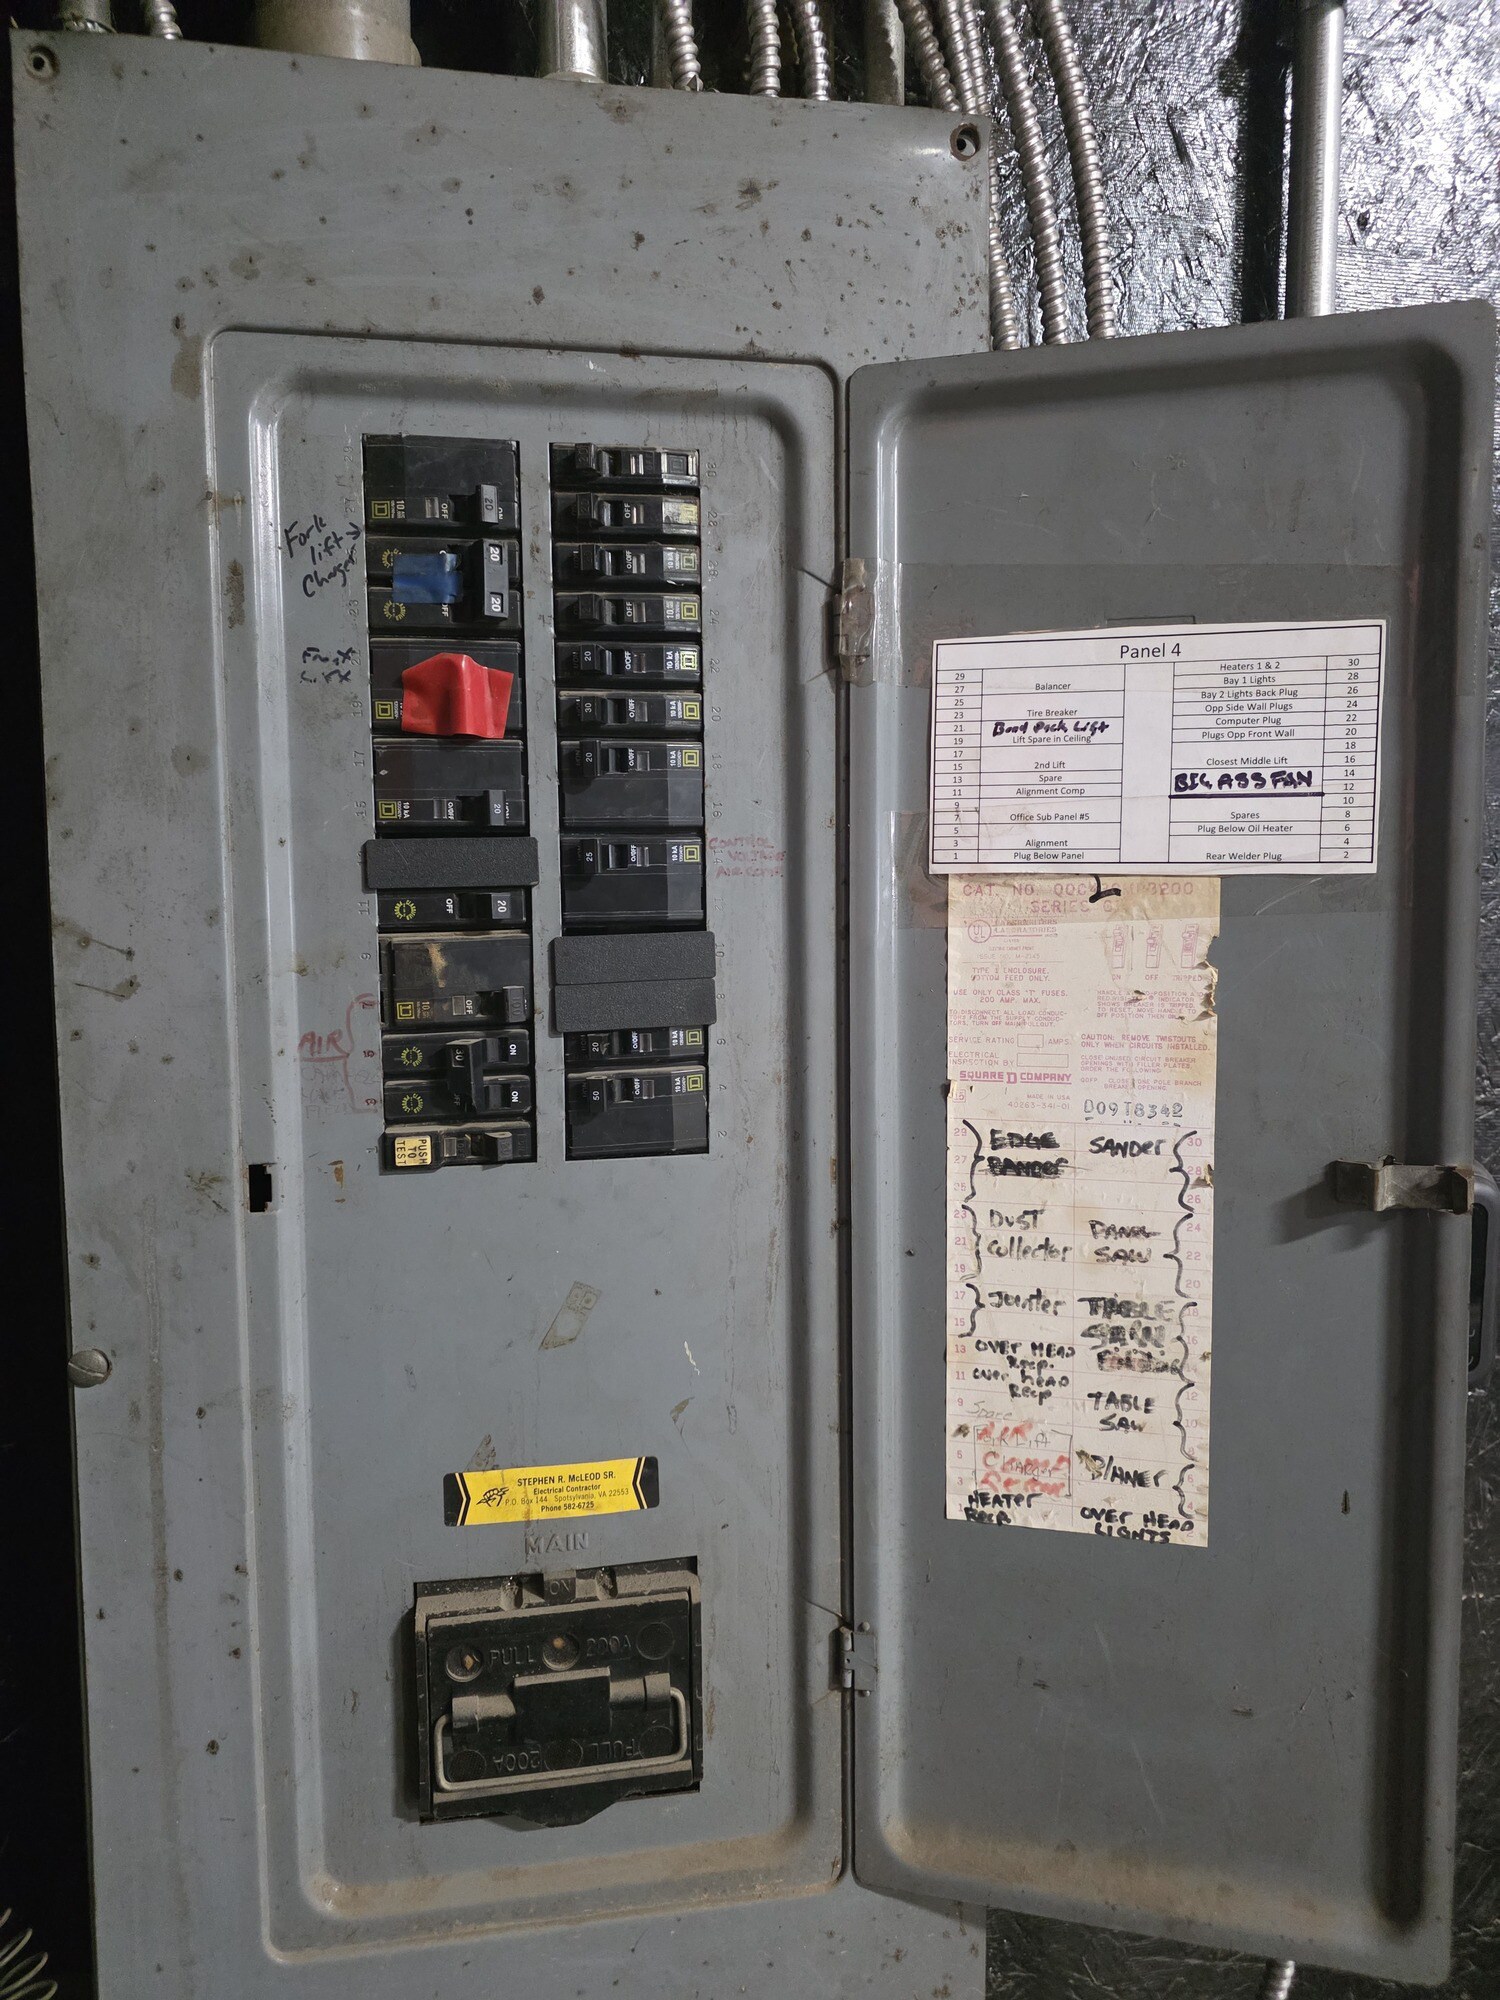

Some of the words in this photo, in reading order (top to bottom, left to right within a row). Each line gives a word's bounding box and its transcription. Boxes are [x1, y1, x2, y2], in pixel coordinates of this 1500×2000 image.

[490, 547, 500, 561] 20
[492, 598, 500, 611] 20
[585, 651, 591, 661] 20
[1120, 644, 1165, 659] Panel
[1170, 643, 1181, 657] 4
[1220, 662, 1254, 670] Heaters
[1348, 658, 1359, 666] 30
[1224, 676, 1239, 685] Bay
[1250, 675, 1276, 684] Lights
[1348, 672, 1359, 680] 28
[1201, 691, 1217, 699] Bay
[1228, 690, 1253, 699] Lights
[1256, 689, 1276, 697] Back
[1280, 688, 1298, 697] Plug
[1347, 686, 1358, 694] 26
[585, 703, 591, 712] 30
[1205, 703, 1223, 713] Opp
[1227, 703, 1245, 711] Side
[1248, 702, 1267, 710] Wall
[1270, 702, 1293, 711] Plugs
[1347, 700, 1358, 708] 24
[1216, 717, 1259, 726] Computer
[1263, 716, 1281, 725] Plug
[1346, 714, 1357, 722] 22
[1202, 730, 1224, 740] Plugs
[1227, 730, 1245, 739] Opp
[1249, 730, 1272, 738] Front
[1275, 729, 1294, 737] Wall
[1346, 728, 1356, 736] 20
[1013, 735, 1026, 743] Lift
[1028, 736, 1051, 744] Spare
[1064, 735, 1091, 743] Ceiling
[586, 752, 592, 762] 20
[1207, 757, 1238, 766] Closest
[1241, 757, 1271, 765] Middle
[1274, 756, 1288, 764] Lift
[1039, 774, 1062, 782] Spare
[1344, 769, 1355, 777] 14
[1174, 772, 1212, 792] BIG
[1217, 772, 1266, 789] ASS
[1270, 770, 1312, 788] FAN
[1016, 787, 1058, 796] Alignment
[1061, 787, 1085, 795] Comp
[1344, 783, 1354, 791] 12
[494, 804, 501, 814] 20
[1010, 813, 1034, 821] Office
[1231, 811, 1260, 820] Spares
[1198, 824, 1217, 834] Plug
[1219, 824, 1246, 832] Below
[1249, 824, 1260, 832] Oil
[1263, 824, 1293, 832] Heater
[1026, 839, 1068, 847] Alignment
[586, 852, 592, 861] 25
[1014, 852, 1031, 860] Plug
[1206, 852, 1225, 860] Rear
[1228, 852, 1260, 860] Welder
[1263, 852, 1282, 861] Plug
[497, 901, 506, 913] 20
[509, 1044, 516, 1056] ON
[592, 1042, 599, 1051] 20
[960, 1071, 1003, 1079] SQUARE
[1006, 1072, 1017, 1084] D
[1020, 1073, 1071, 1081] COMPANY
[512, 1091, 518, 1103] ON
[593, 1091, 599, 1100] 50
[397, 1141, 405, 1164] TEST
[408, 1147, 416, 1158] TO
[418, 1139, 427, 1165] PUSH
[1087, 1391, 1154, 1414] TABLE
[518, 1477, 554, 1486] STEPHEN
[558, 1475, 565, 1484] R.
[568, 1473, 601, 1483] McLEOD
[603, 1471, 616, 1480] SR.
[534, 1486, 564, 1495] Electrical
[566, 1484, 601, 1493] Contractor
[536, 1496, 548, 1504] 144
[598, 1490, 606, 1498] VA
[609, 1488, 629, 1497] 22553
[541, 1504, 561, 1512] Phone
[564, 1501, 594, 1510] 582-6725
[525, 1533, 589, 1554] MAIN
[551, 1578, 570, 1596] ON
[489, 1646, 535, 1666] PULL
[586, 1635, 631, 1657] 200A
